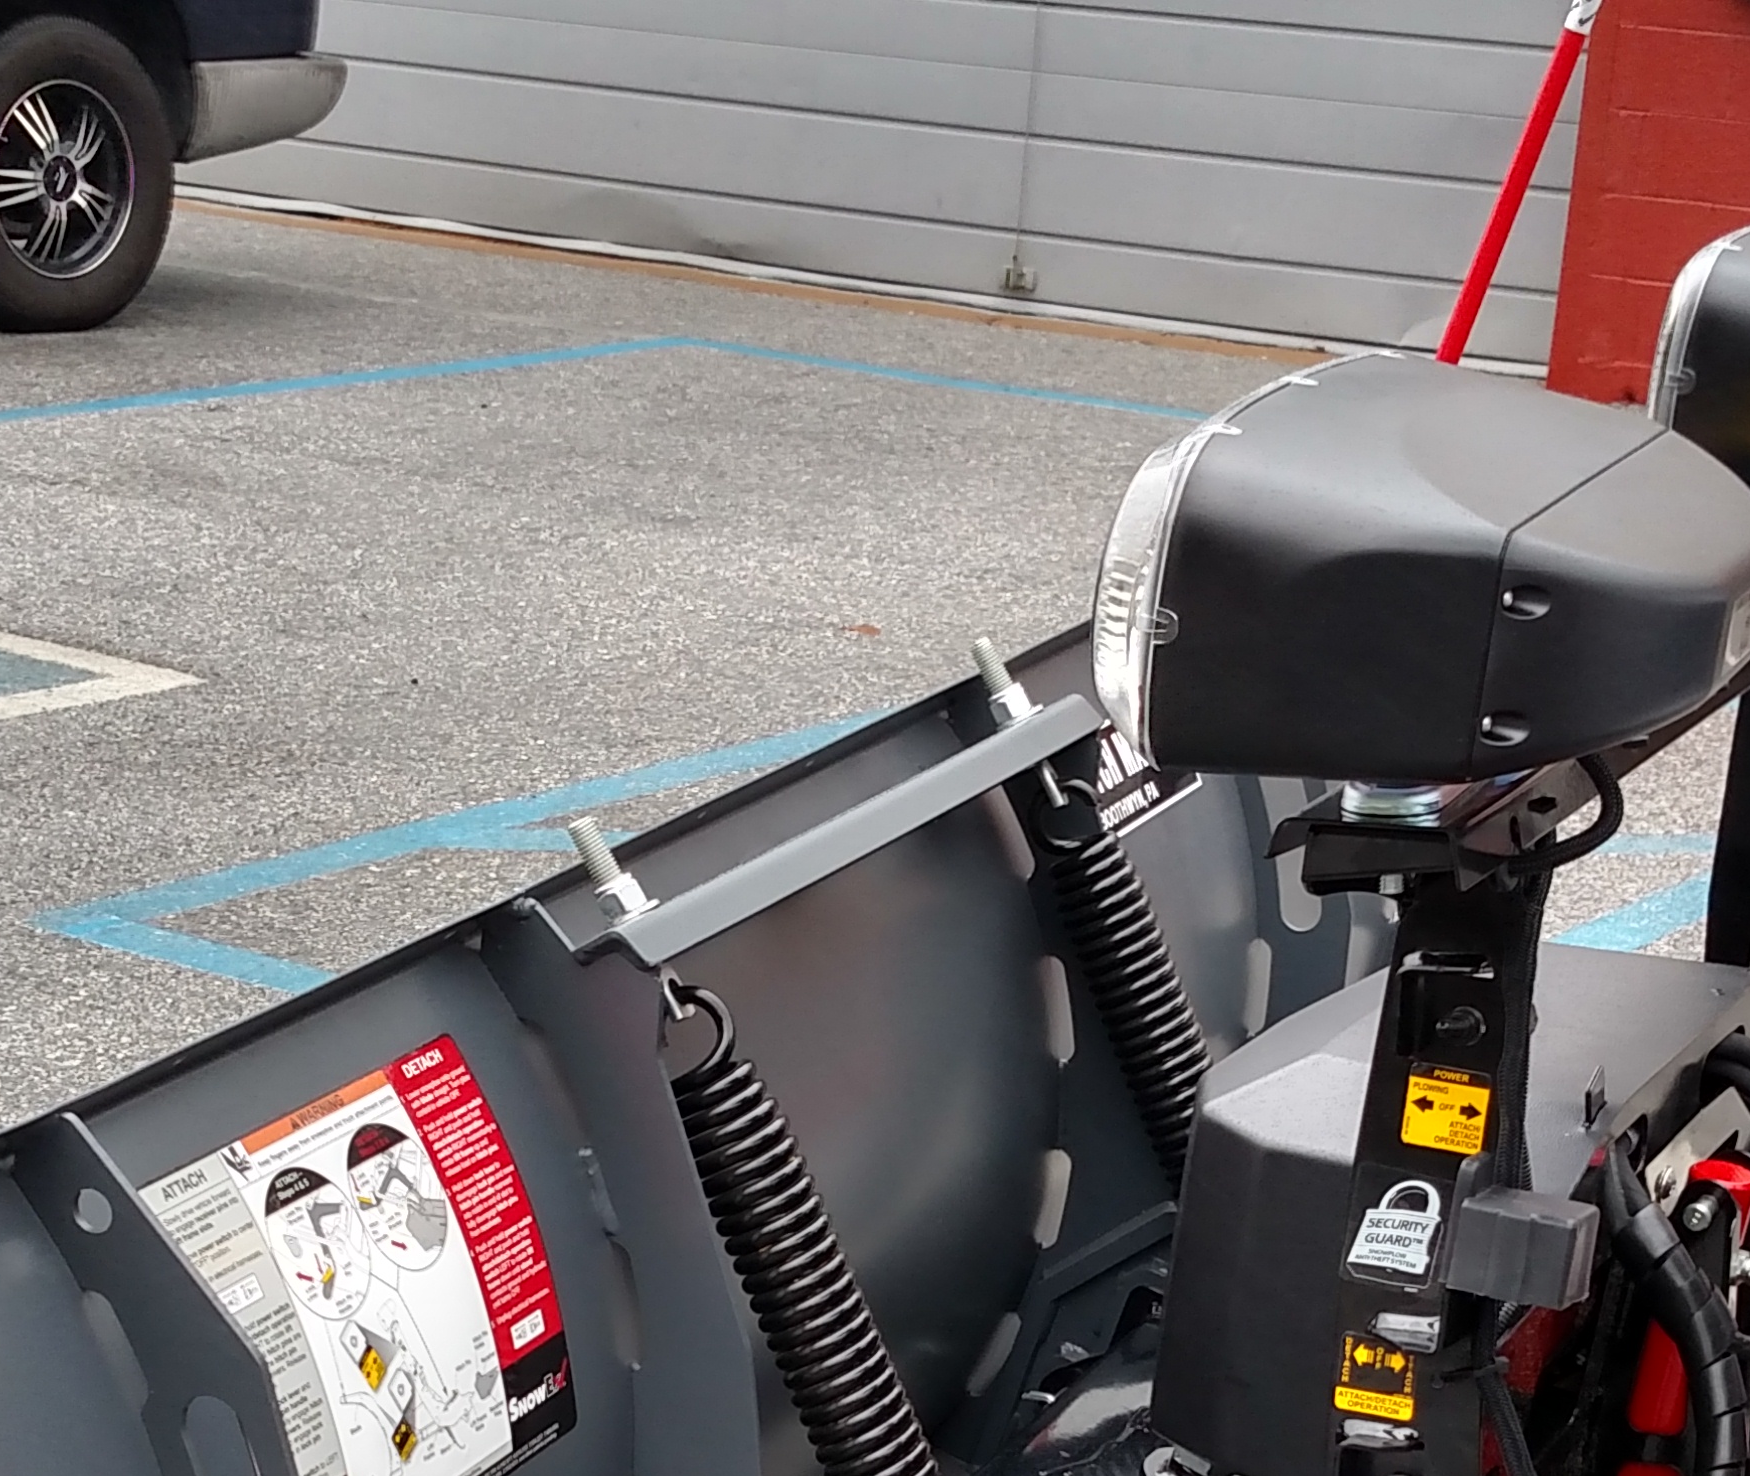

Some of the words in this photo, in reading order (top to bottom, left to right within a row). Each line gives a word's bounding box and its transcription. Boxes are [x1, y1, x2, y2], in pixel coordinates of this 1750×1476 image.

[1144, 781, 1160, 802] PA
[401, 1048, 444, 1079] DETACH
[1434, 1069, 1470, 1083] POWER
[1413, 1082, 1449, 1094] PLOWING
[296, 1094, 344, 1126] WARNING
[1439, 1103, 1455, 1111] OFF
[1434, 1135, 1478, 1149] OPERATION
[1449, 1130, 1479, 1140] DETACH
[161, 1168, 207, 1202] ATTACH
[1366, 1218, 1429, 1233] SECURITY
[1368, 1249, 1406, 1259] SNOWPLOW
[1391, 1259, 1417, 1268] SYSTEM
[1403, 1355, 1414, 1393] TTACH
[1338, 1390, 1410, 1409] ATTACH/DETACH
[1347, 1400, 1399, 1415] OPERATION
